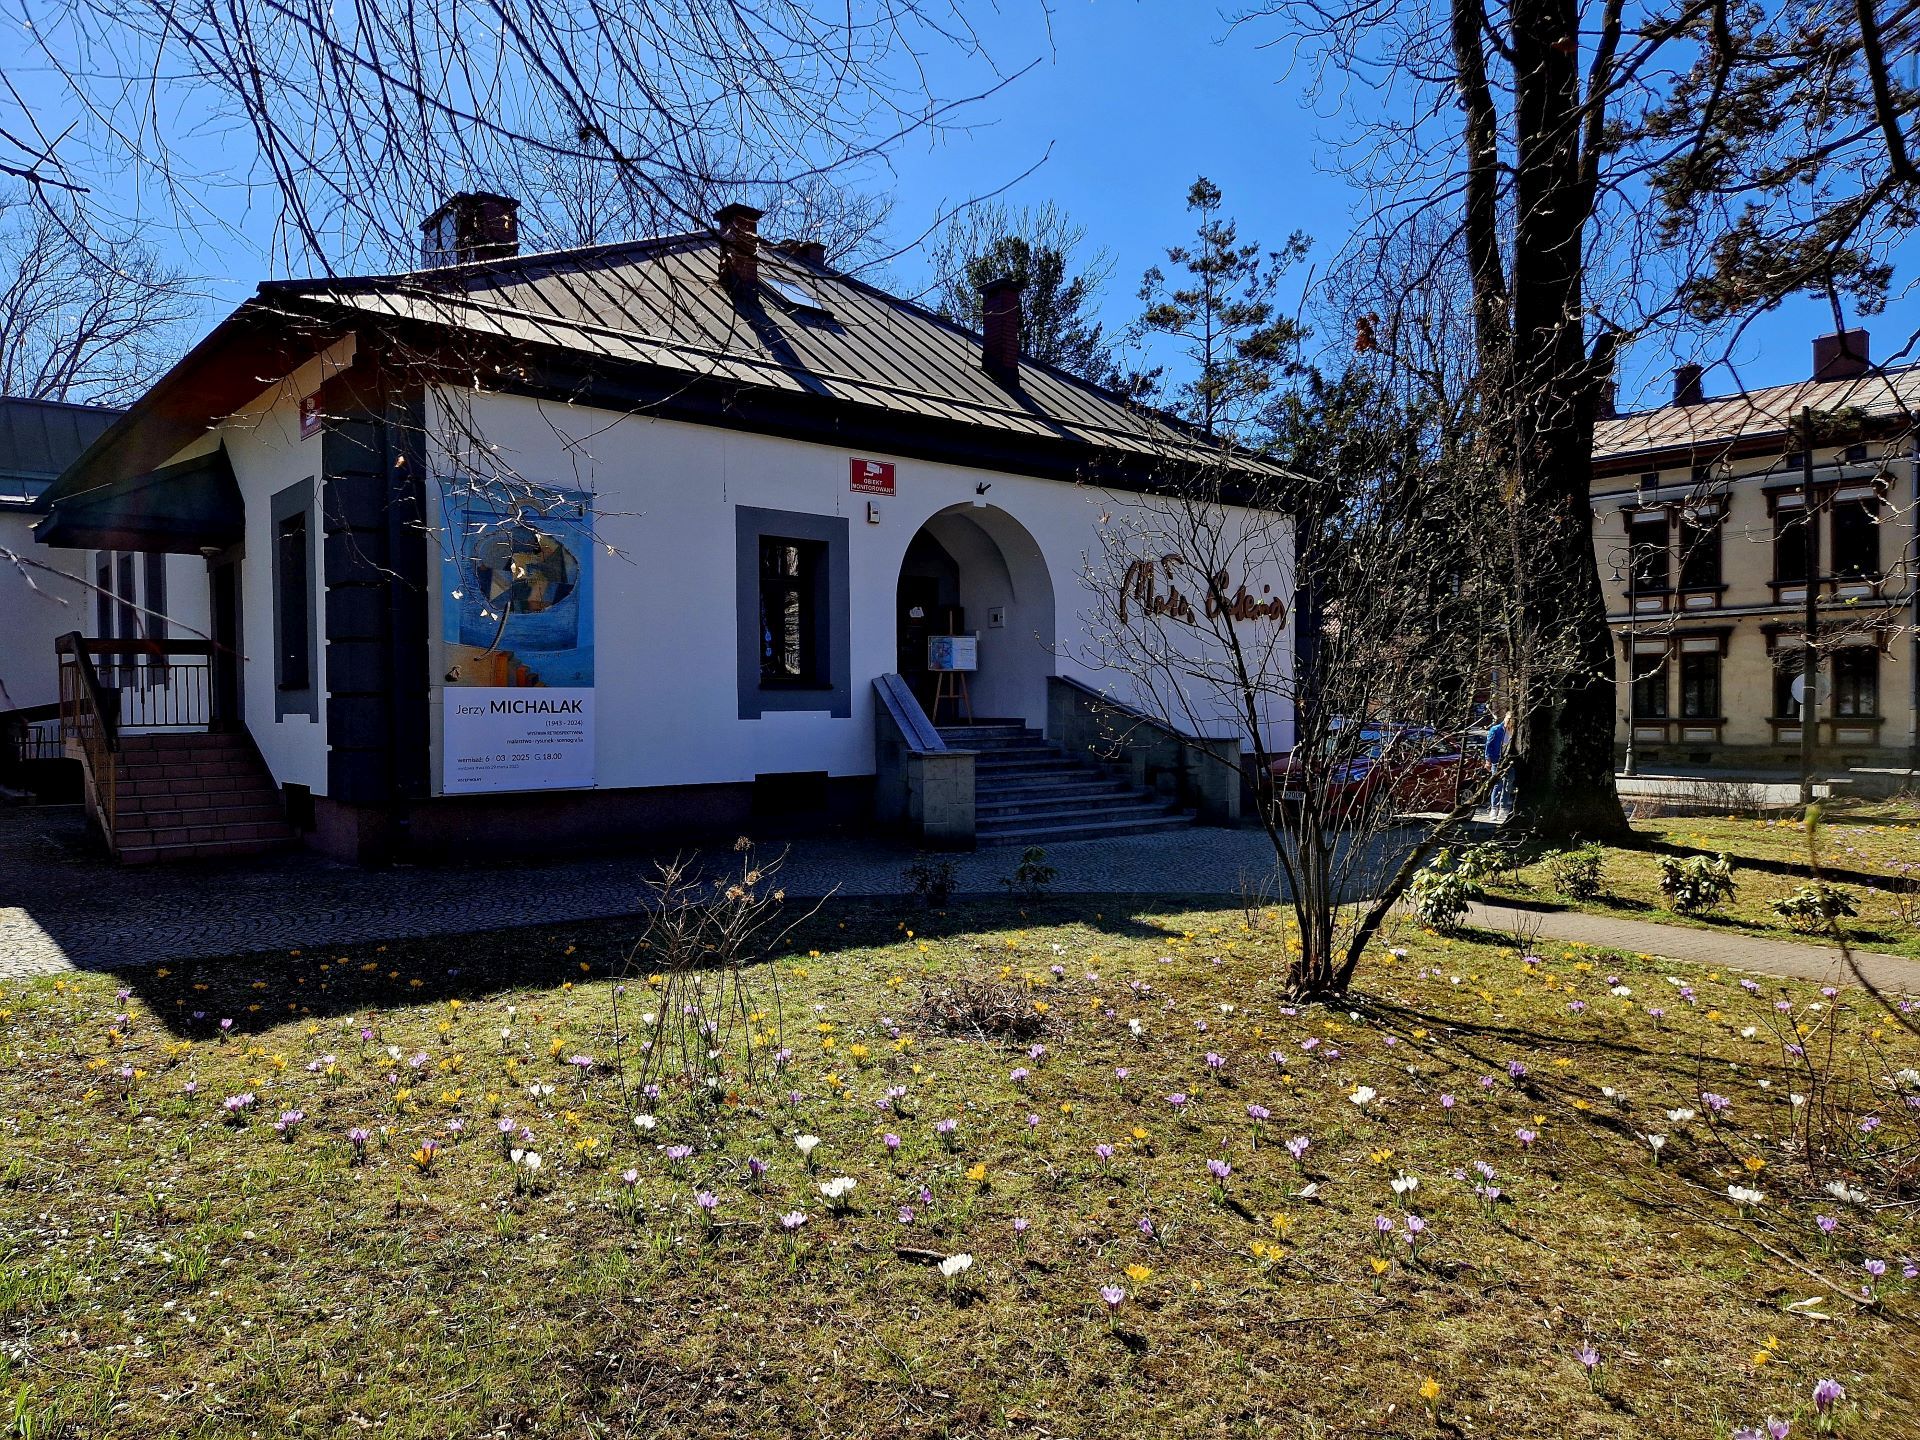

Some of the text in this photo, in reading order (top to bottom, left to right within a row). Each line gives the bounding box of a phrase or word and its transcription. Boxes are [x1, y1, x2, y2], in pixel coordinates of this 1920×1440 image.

[852, 483, 894, 493] MONITOROWANY
[456, 699, 583, 717] Jerzy MICHALAK
[495, 754, 506, 762] 03
[511, 753, 530, 761] 2025
